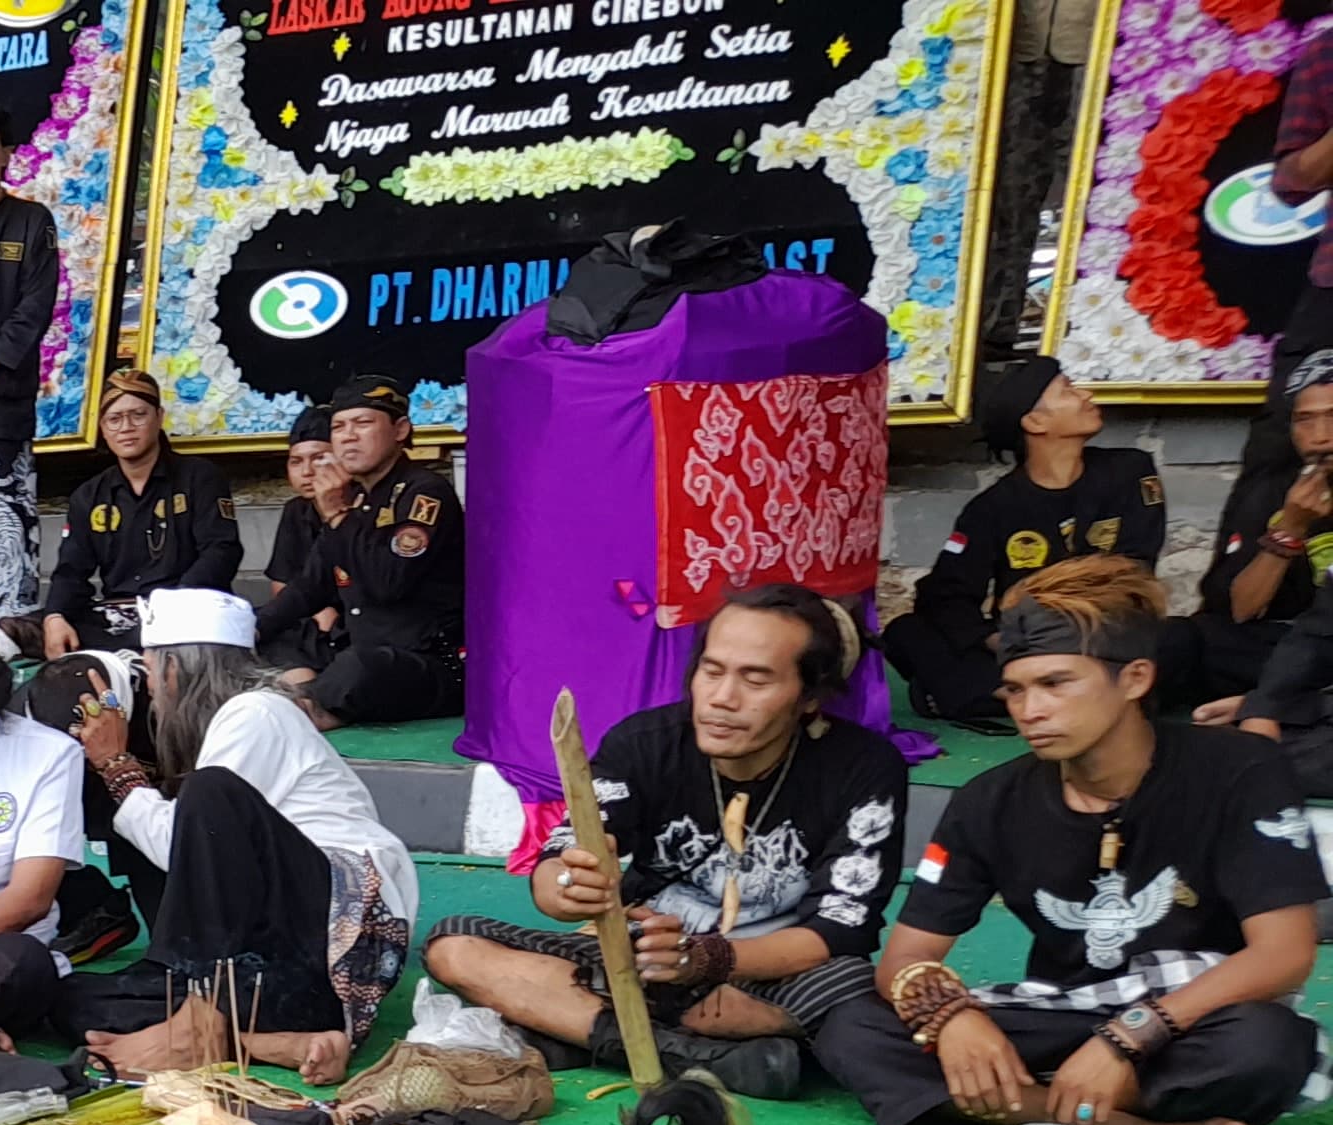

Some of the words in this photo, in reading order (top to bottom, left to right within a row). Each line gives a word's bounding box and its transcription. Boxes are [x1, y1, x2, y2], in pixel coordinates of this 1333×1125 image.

[317, 68, 497, 108] Dasawarsa
[515, 30, 688, 88] Mengabdi
[703, 23, 794, 60] Setia
[387, 3, 574, 54] KESULTANAN
[314, 116, 411, 160] Njaga
[431, 95, 571, 140] Marwah
[590, 75, 791, 122] Kesultanan
